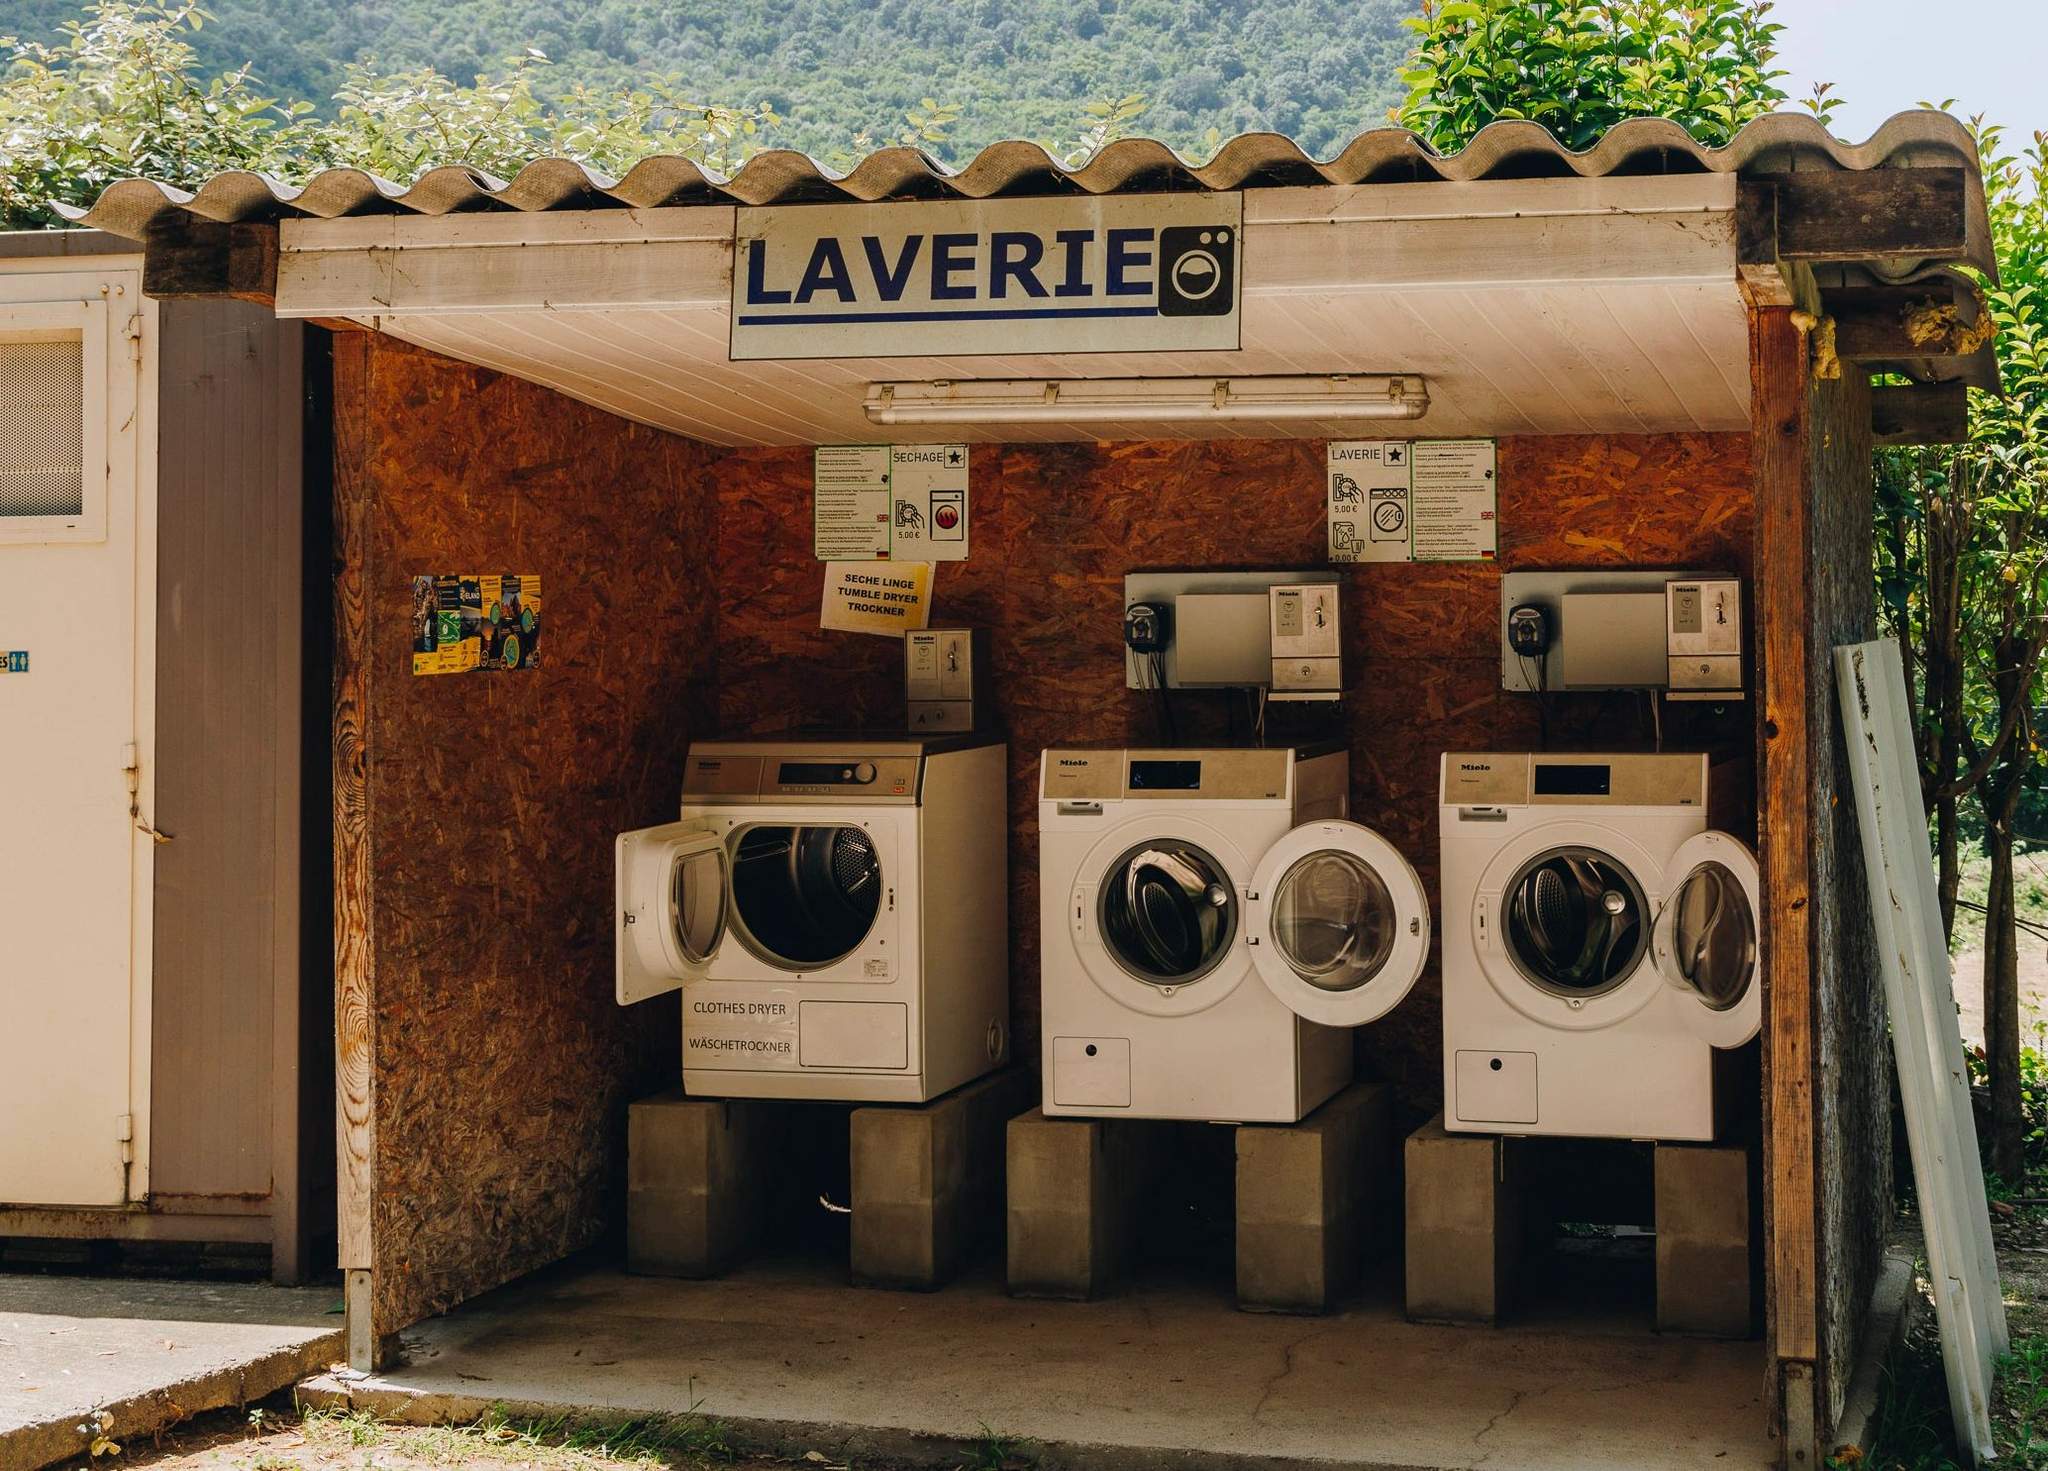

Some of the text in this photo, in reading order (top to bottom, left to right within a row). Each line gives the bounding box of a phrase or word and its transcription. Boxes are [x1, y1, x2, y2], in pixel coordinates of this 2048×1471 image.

[747, 228, 1155, 304] LAVERIE
[893, 452, 944, 462] SECHAGE
[1332, 449, 1380, 460] LAVERIE
[1334, 505, 1350, 513] 5,00
[898, 531, 913, 539] 5,00
[845, 574, 915, 589] SECHE LINGE
[838, 587, 919, 604] TUMBLE DRYER
[848, 602, 905, 616] TROCKNER
[1059, 759, 1088, 767] Miele
[694, 1002, 786, 1015] CLOTHES DRYER
[689, 1037, 791, 1053] WÄSCHETROCKNER
